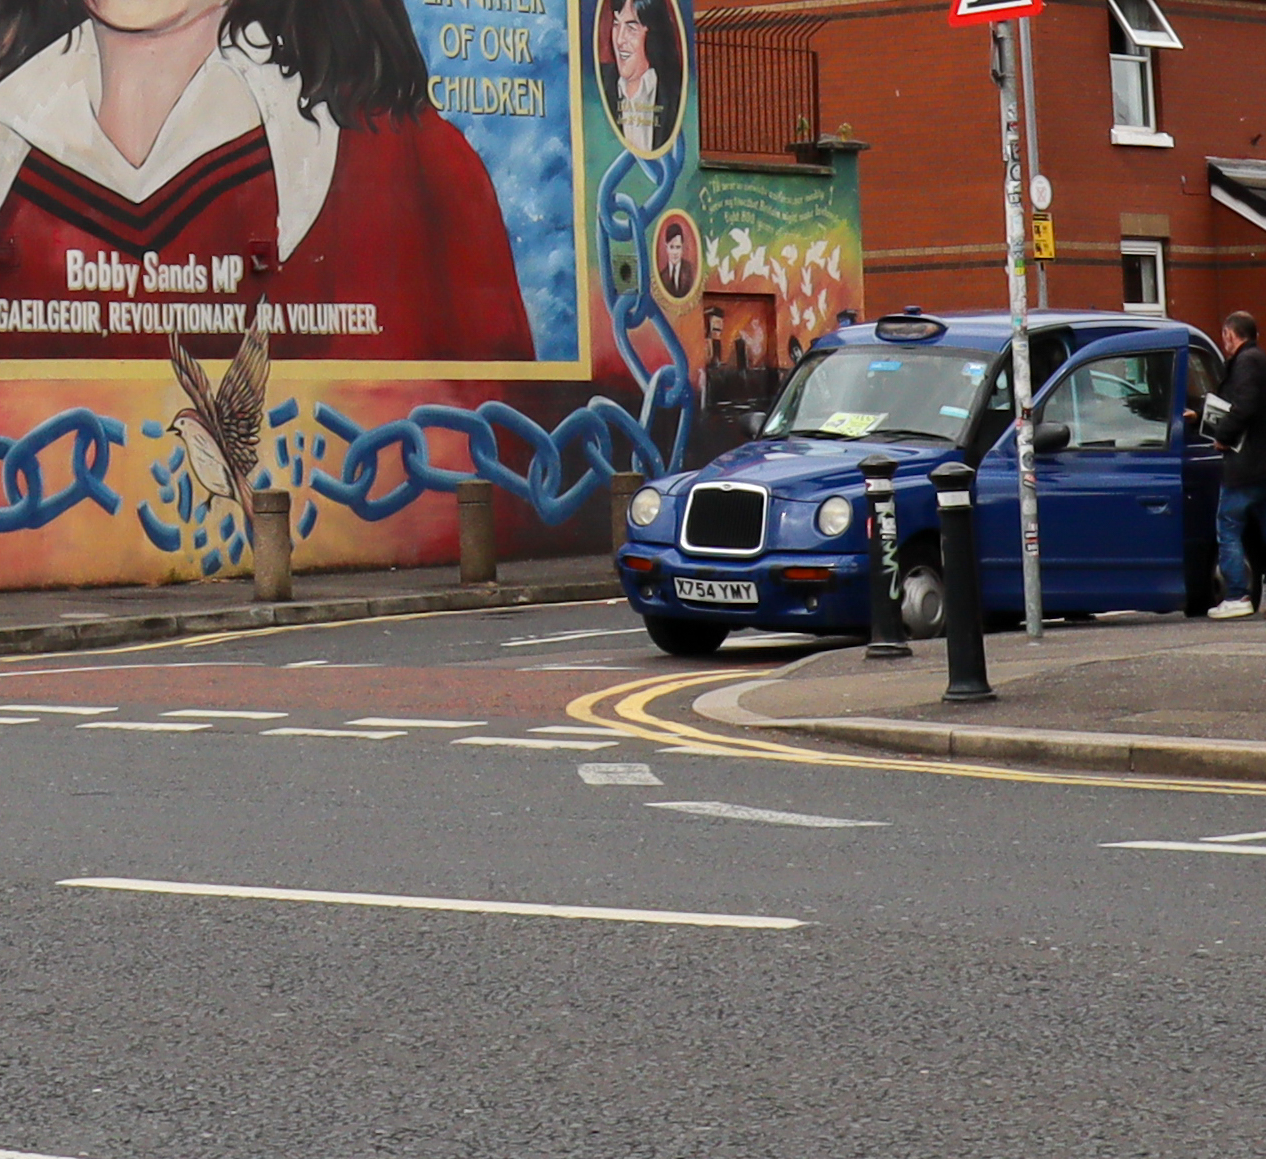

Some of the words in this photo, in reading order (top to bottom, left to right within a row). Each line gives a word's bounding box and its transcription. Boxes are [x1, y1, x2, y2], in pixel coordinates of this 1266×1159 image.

[440, 23, 475, 60] OF
[480, 26, 533, 64] OUR
[427, 75, 546, 117] CHILDREN
[66, 248, 140, 298] Bobby
[143, 251, 208, 294] Sands
[212, 254, 244, 294] MP
[257, 303, 286, 334] IRA
[287, 303, 384, 334] VOLUNTEER.
[676, 578, 716, 599] X754
[718, 583, 752, 600] YMY
